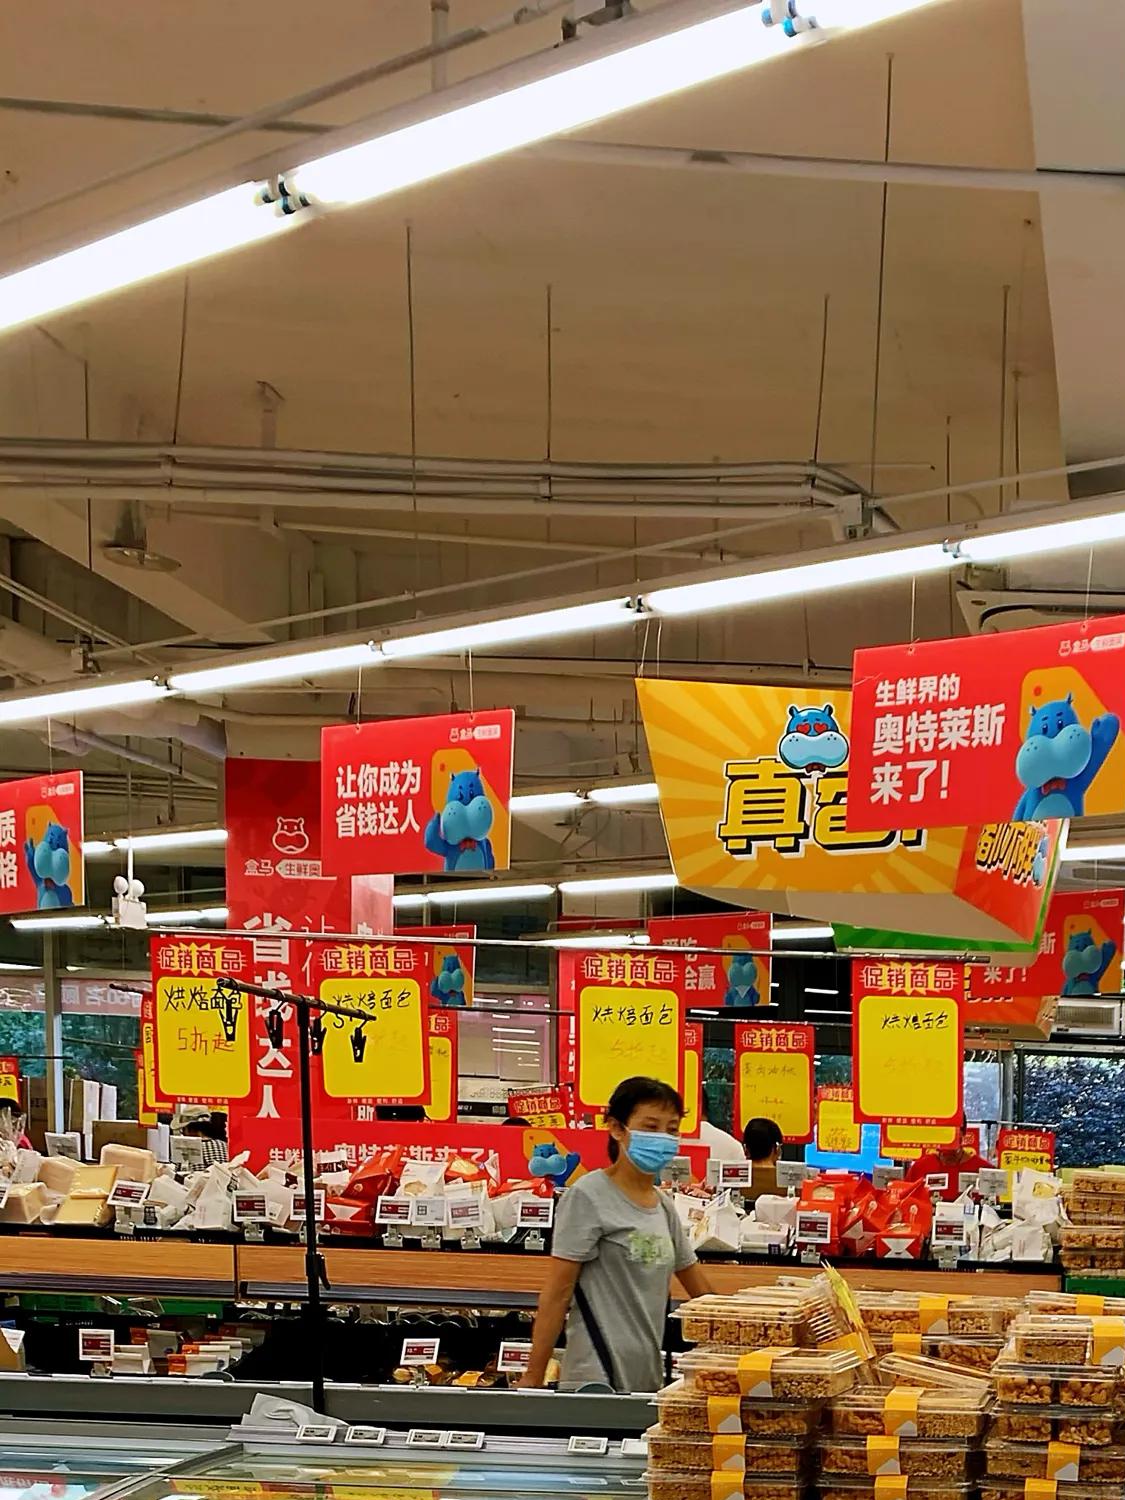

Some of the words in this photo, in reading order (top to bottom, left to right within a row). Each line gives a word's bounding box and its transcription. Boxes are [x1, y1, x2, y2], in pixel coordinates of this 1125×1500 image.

[875, 674, 960, 707] 生鲜界的
[872, 703, 1006, 756] 奥特莱斯
[336, 759, 421, 799] 让你成为
[871, 759, 949, 805] 来了!
[336, 799, 420, 839] 省钱达人
[244, 859, 274, 876] 盒马
[285, 862, 321, 877] 生鲜奥
[159, 948, 242, 972] 促销商品
[323, 949, 414, 972] 促销商品
[584, 958, 674, 981] 促销商品
[863, 966, 954, 990] 促销商品
[164, 984, 242, 1012] 烘焙面包
[592, 1003, 674, 1026] 烘焙面包
[178, 1026, 235, 1055] 5折起
[742, 1031, 808, 1050] 促销商品
